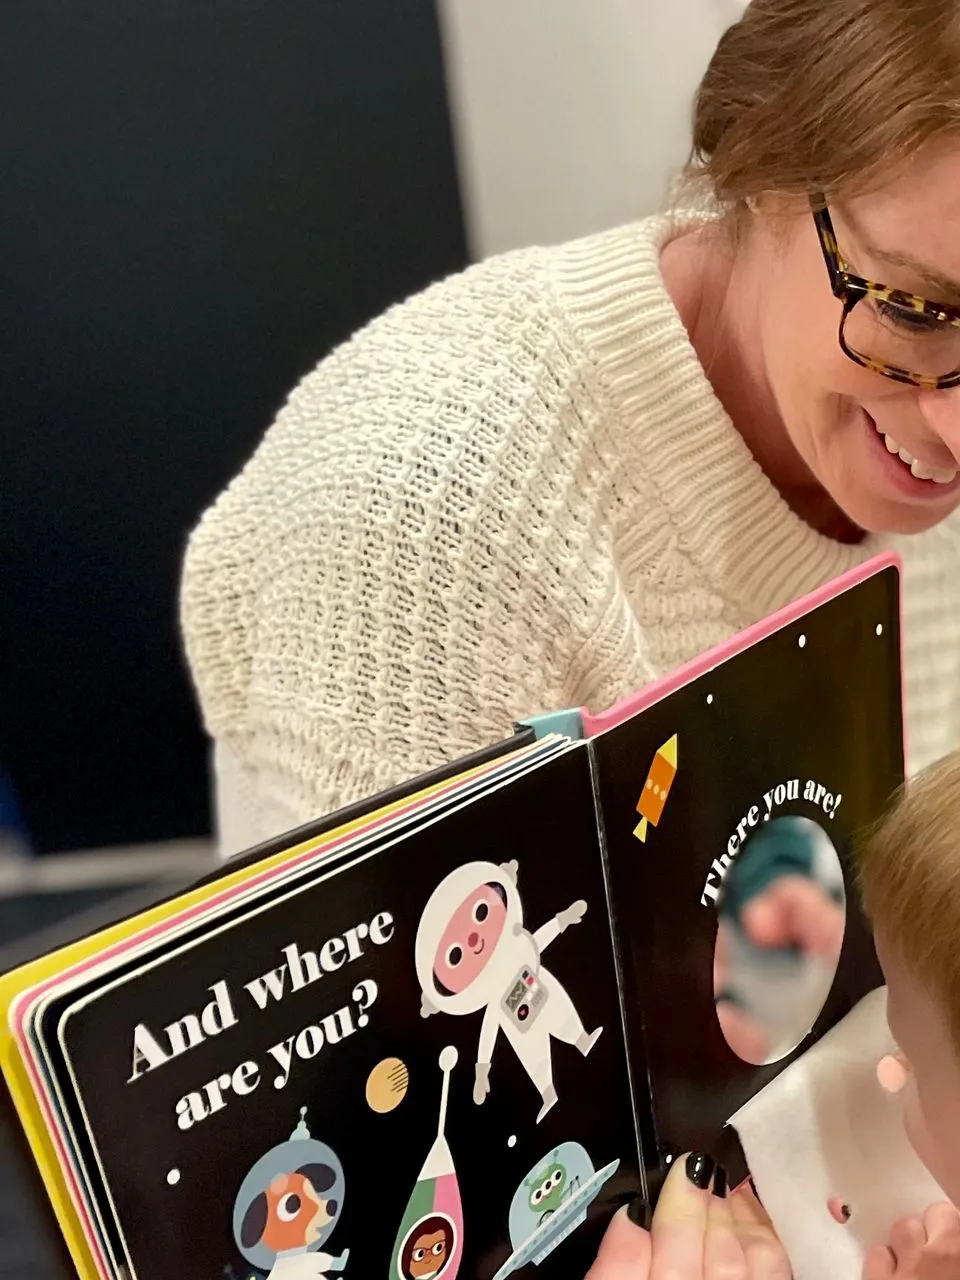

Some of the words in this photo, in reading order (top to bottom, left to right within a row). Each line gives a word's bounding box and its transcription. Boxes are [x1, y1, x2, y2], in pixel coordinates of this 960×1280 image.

[701, 804, 760, 908] There
[763, 779, 800, 821] you
[803, 779, 842, 820] are!
[127, 979, 239, 1084] And
[243, 911, 395, 1010] where
[175, 1060, 261, 1130] are
[266, 979, 378, 1089] you?
